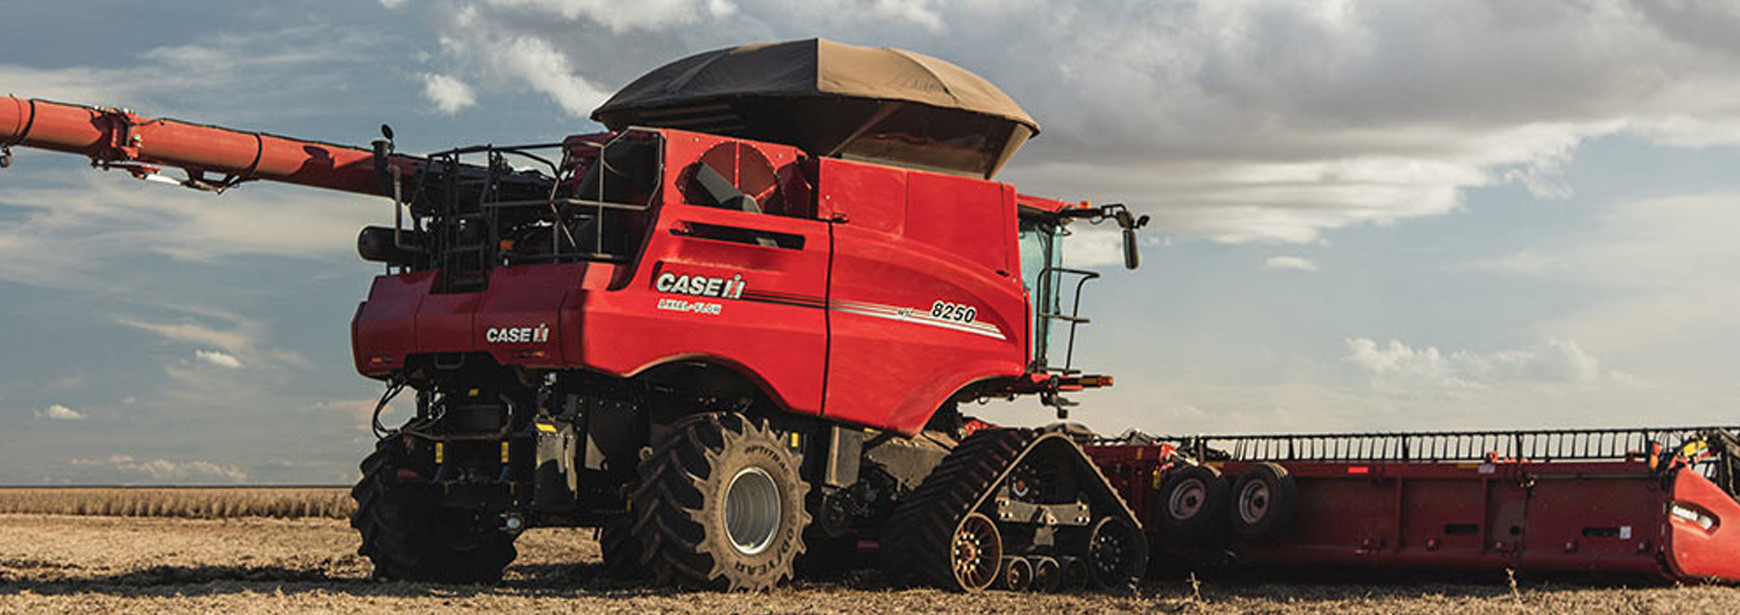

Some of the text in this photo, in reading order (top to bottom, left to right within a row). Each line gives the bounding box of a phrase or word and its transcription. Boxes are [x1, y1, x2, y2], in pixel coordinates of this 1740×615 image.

[656, 273, 723, 297] CASE
[931, 300, 977, 324] 8250
[486, 327, 532, 342] CASE
